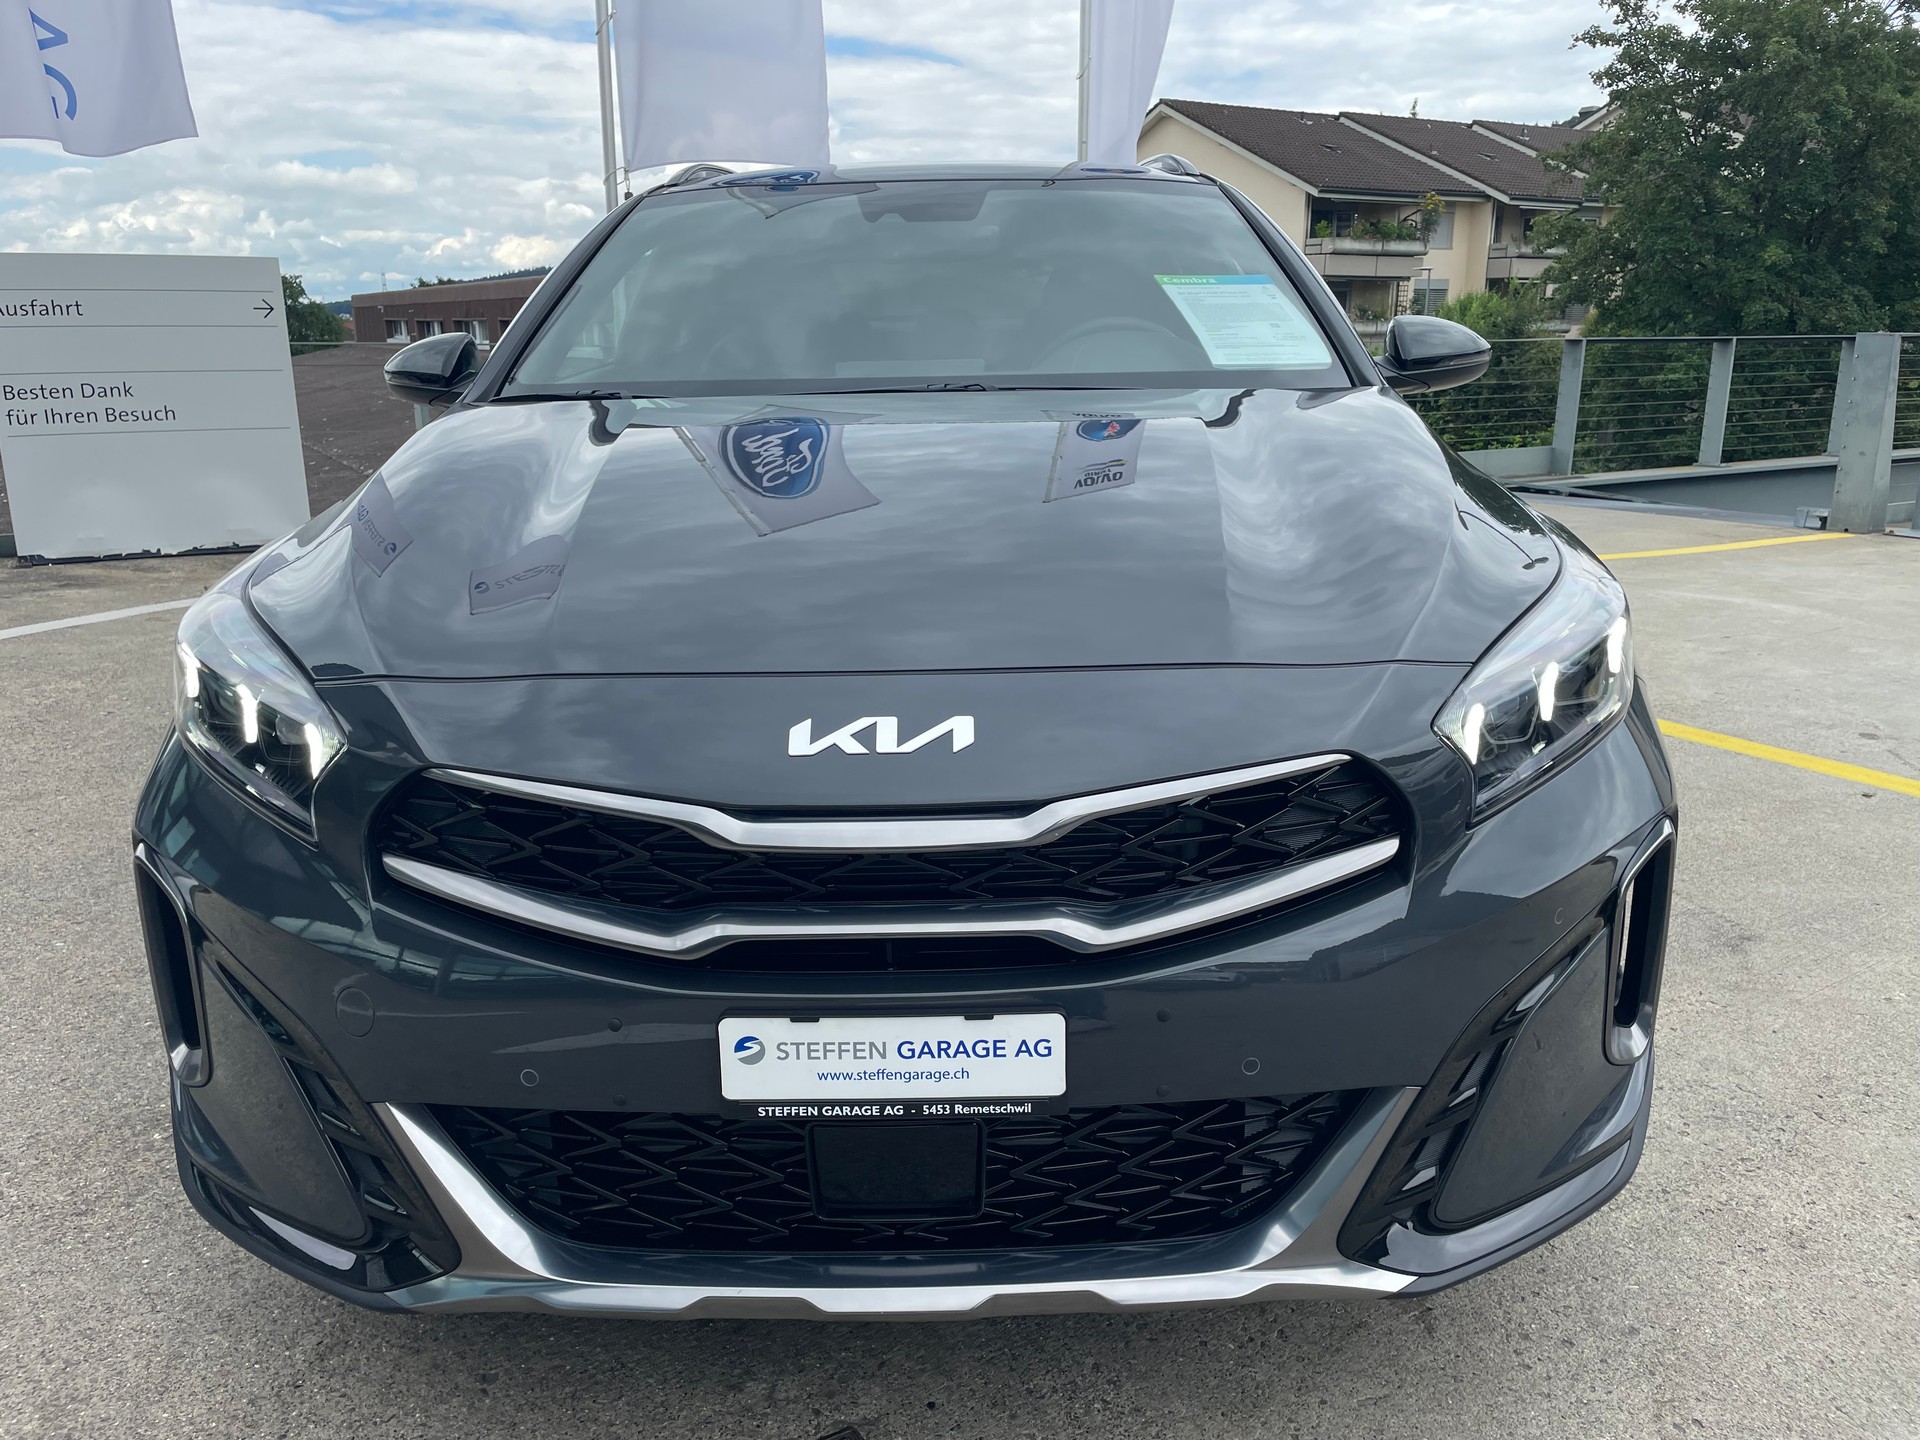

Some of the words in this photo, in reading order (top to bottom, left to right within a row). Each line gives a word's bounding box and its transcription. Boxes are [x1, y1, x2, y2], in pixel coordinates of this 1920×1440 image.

[1163, 276, 1217, 284] Cembra
[3, 384, 74, 401] Besten
[80, 381, 134, 399] Dank
[5, 408, 38, 426] für
[44, 408, 99, 425] Ihren
[105, 405, 176, 423] Besuch
[776, 1041, 887, 1061] STEFFEN
[897, 1039, 1006, 1060] GARAGE
[1014, 1038, 1053, 1058] AG
[816, 1067, 970, 1083] www.steffengarage.ch
[758, 1106, 818, 1117] STEFFEN
[821, 1105, 881, 1117] GARAGE
[883, 1105, 904, 1116] AG
[922, 1104, 951, 1115] 5453
[954, 1103, 1032, 1115] Remetschwil
